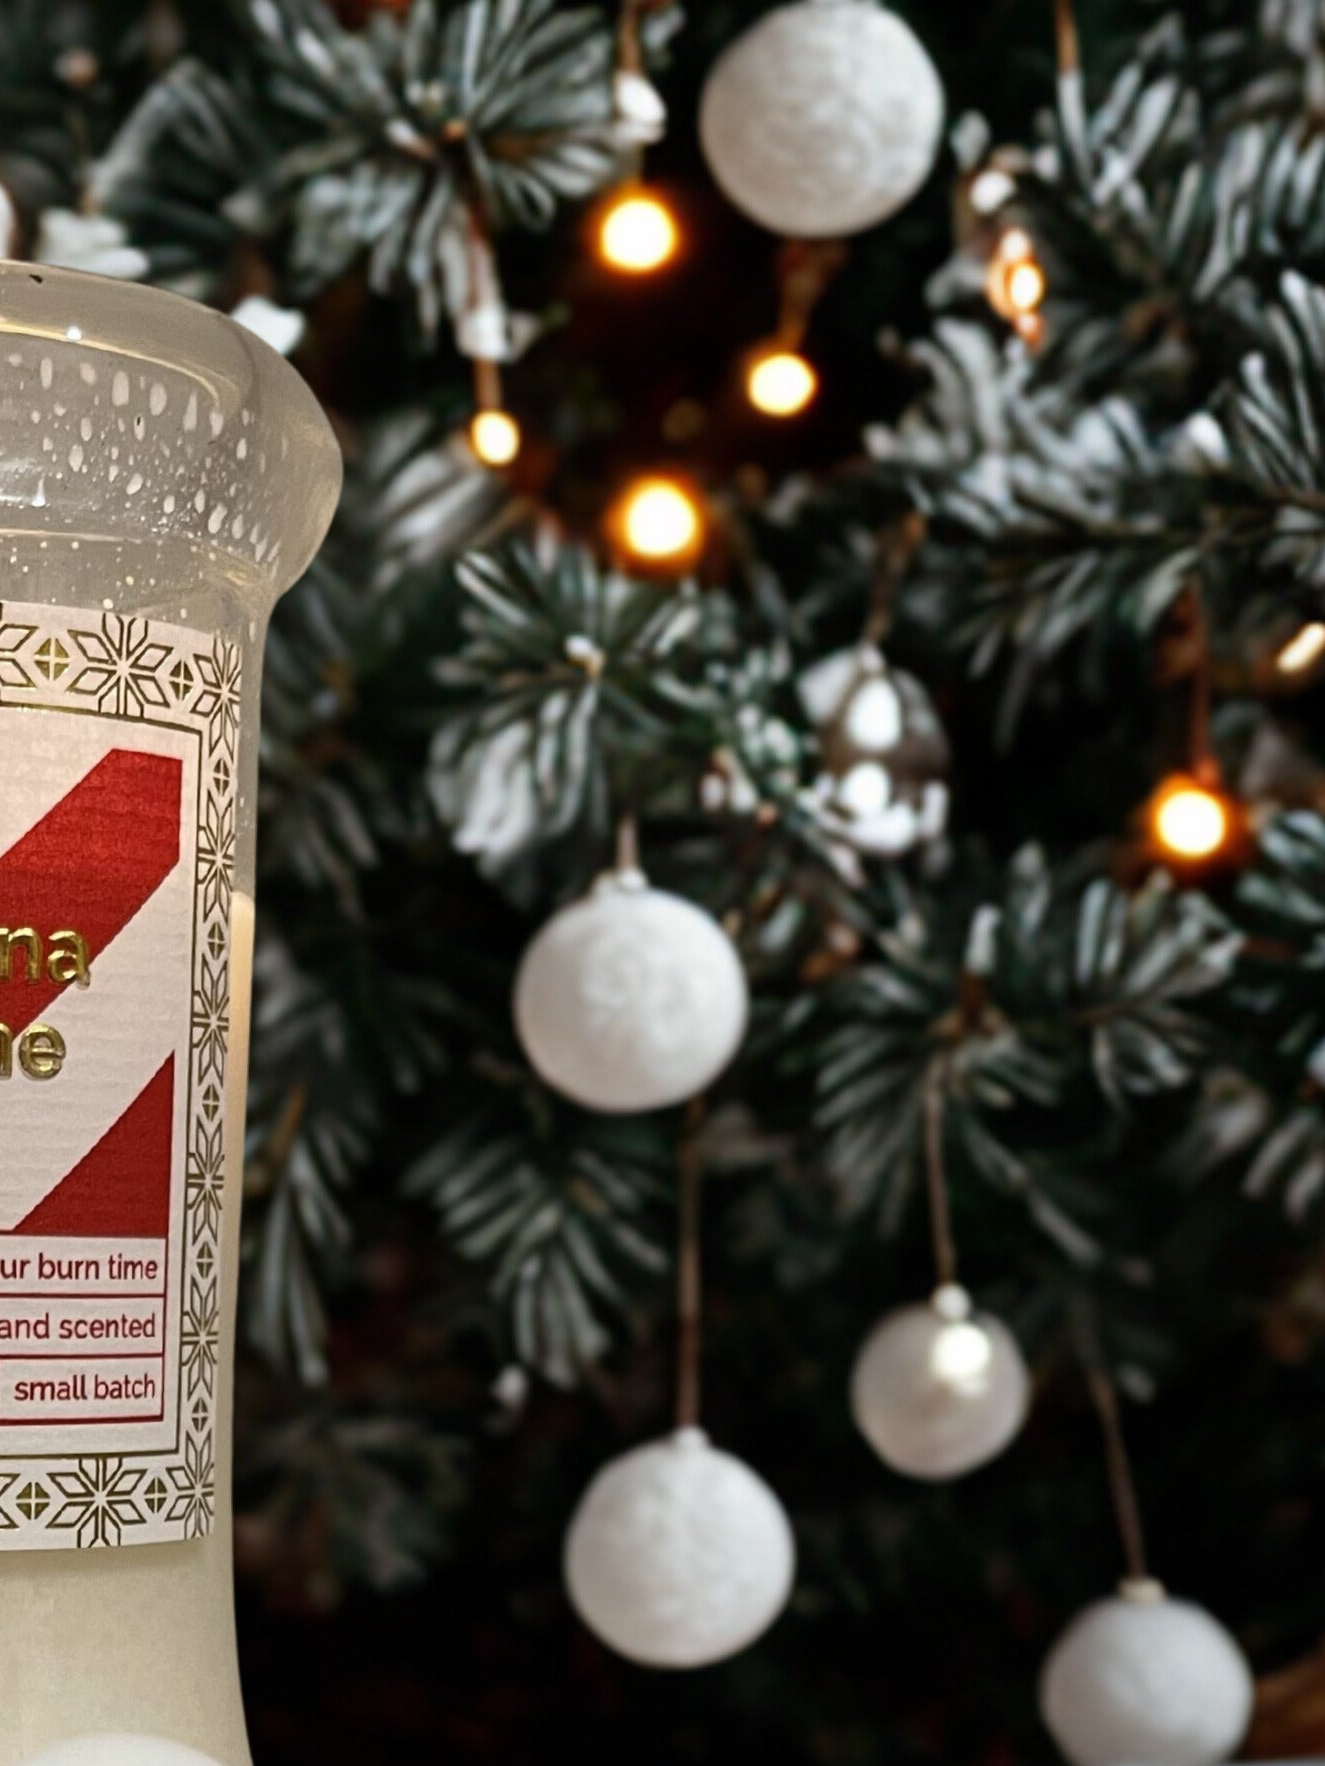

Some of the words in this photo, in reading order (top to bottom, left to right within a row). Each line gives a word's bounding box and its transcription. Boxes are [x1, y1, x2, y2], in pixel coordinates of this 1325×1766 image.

[38, 1253, 100, 1280] burn
[107, 1254, 159, 1280] time
[59, 1312, 156, 1340] scented
[14, 1374, 88, 1401] small
[94, 1373, 156, 1400] batch
